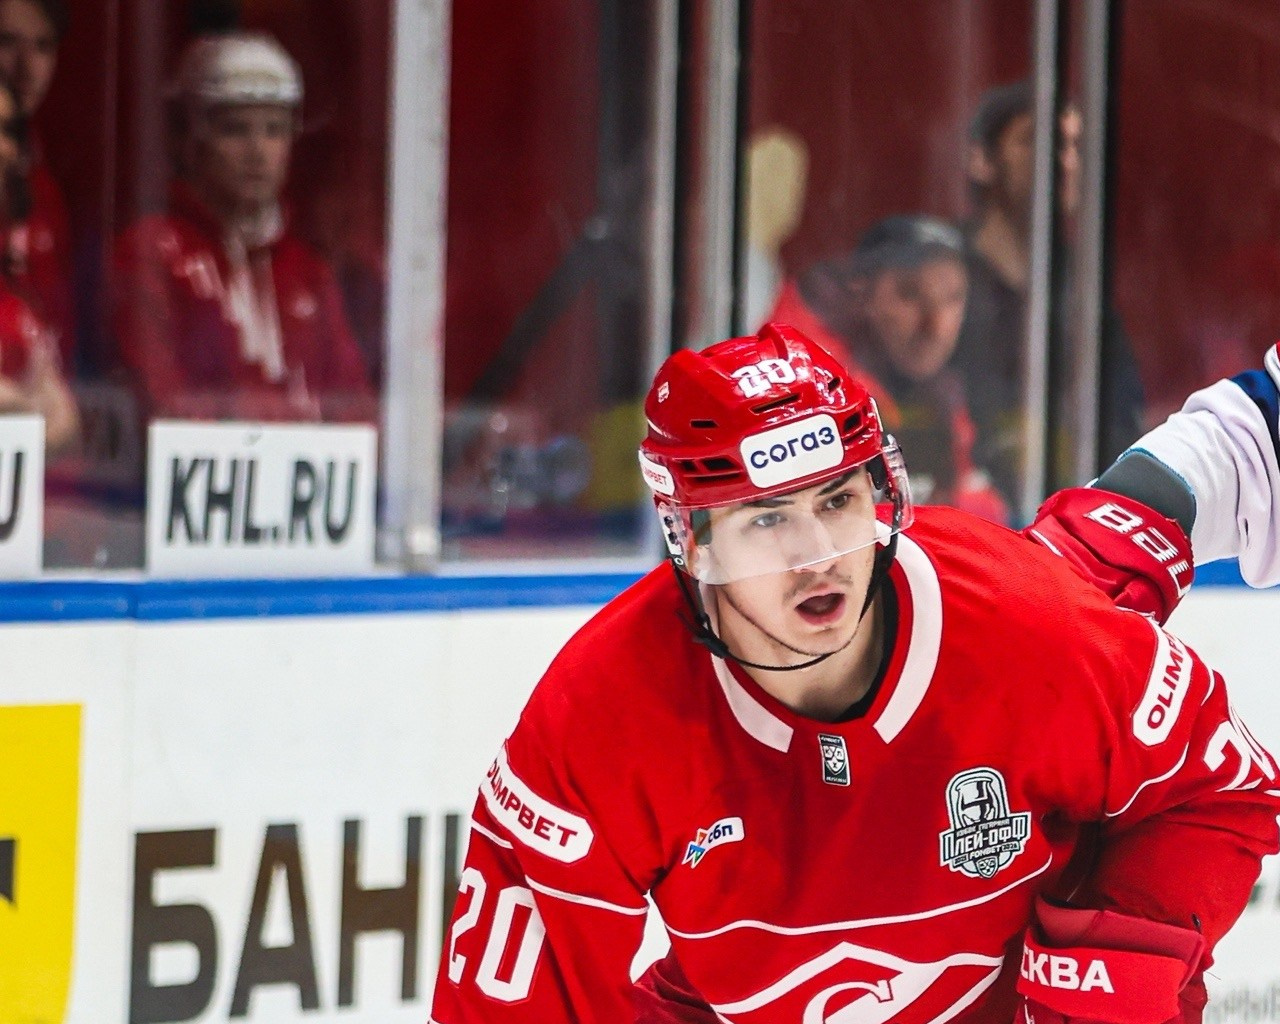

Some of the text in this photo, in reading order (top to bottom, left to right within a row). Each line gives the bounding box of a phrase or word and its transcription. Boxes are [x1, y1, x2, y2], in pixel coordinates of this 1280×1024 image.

[730, 358, 797, 398] 20
[750, 426, 836, 469] согаз
[164, 456, 358, 547] KHL.RU
[708, 823, 733, 844] сбп
[448, 866, 546, 1004] 20
